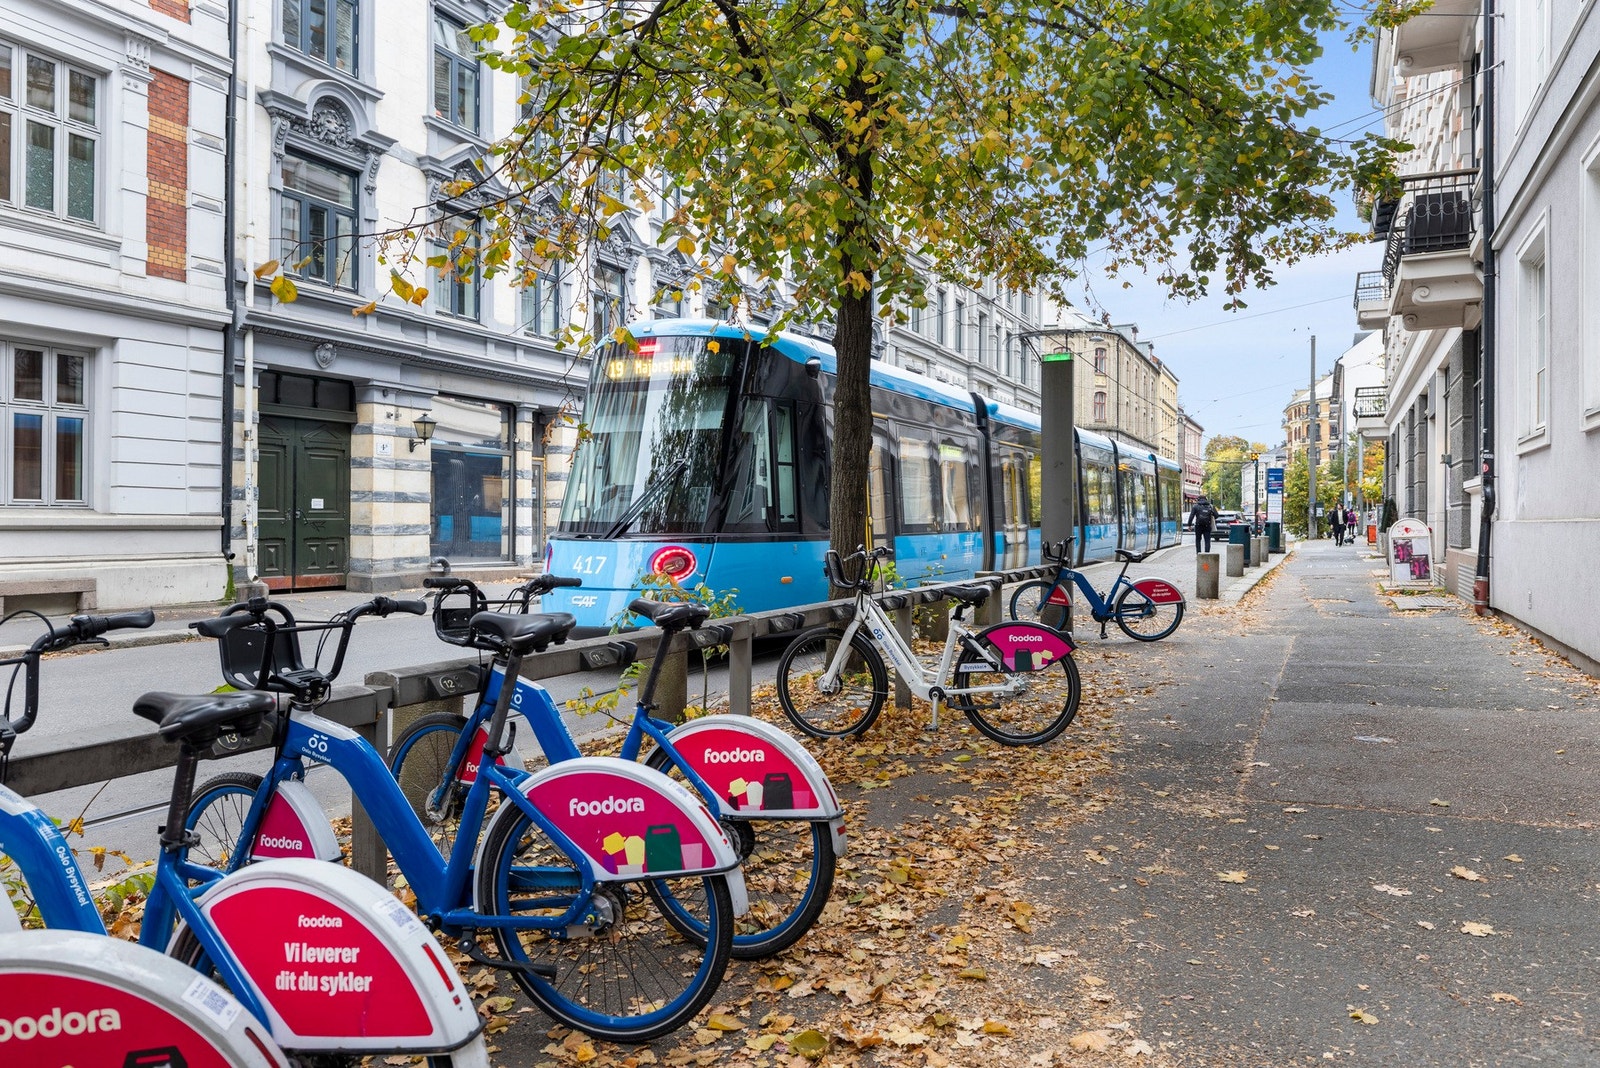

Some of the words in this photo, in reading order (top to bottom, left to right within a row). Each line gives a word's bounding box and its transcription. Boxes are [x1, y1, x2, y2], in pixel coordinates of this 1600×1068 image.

[609, 360, 625, 378] 19
[634, 358, 694, 377] Majorstuen
[572, 555, 608, 575] 417
[1008, 634, 1043, 643] foodora
[442, 679, 456, 689] 12
[225, 733, 238, 744] 13
[704, 747, 765, 764] foodora
[569, 796, 645, 817] foodora
[260, 834, 303, 850] foodora
[56, 846, 71, 867] Oslo
[65, 866, 90, 907] Bysykkel
[298, 914, 343, 928] foodora
[284, 942, 300, 963] Vi
[302, 942, 360, 963] leverer
[276, 970, 297, 991] dit
[298, 971, 318, 992] du
[320, 971, 373, 997] sykler
